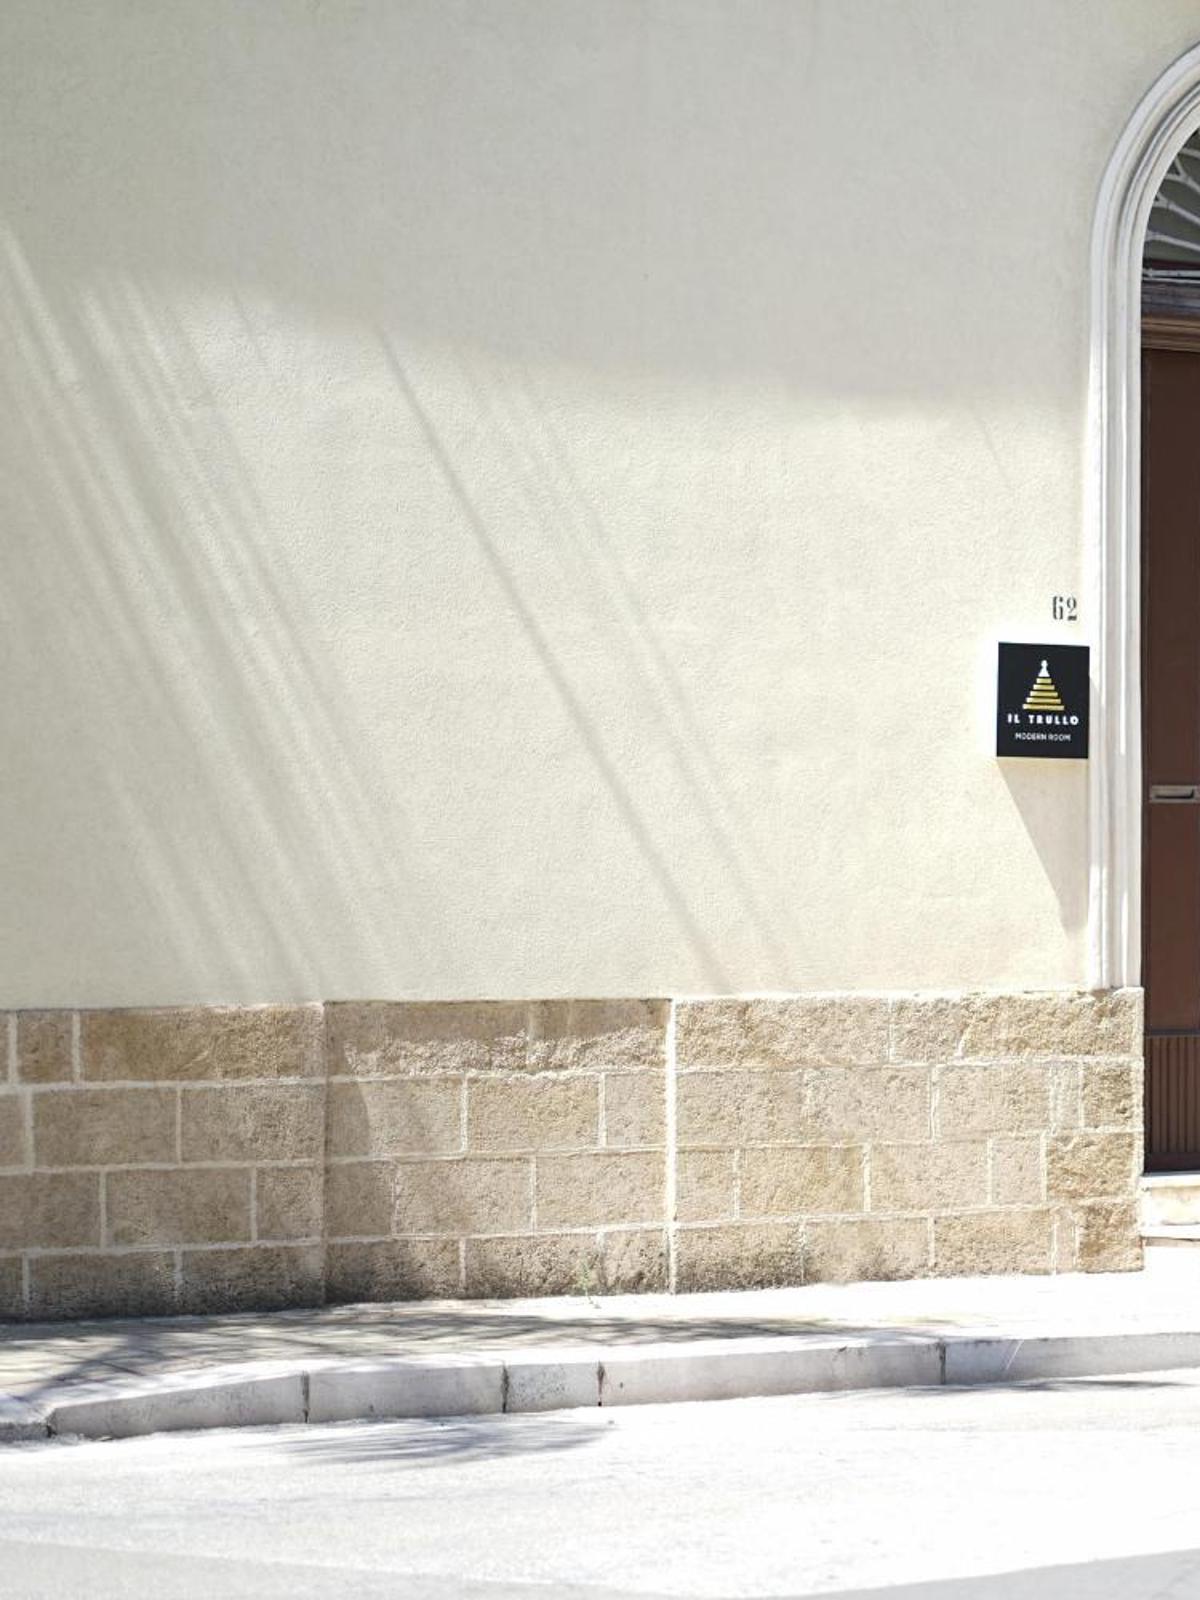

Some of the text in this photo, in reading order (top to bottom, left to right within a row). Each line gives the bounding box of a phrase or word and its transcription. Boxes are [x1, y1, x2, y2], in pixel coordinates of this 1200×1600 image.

[1052, 595, 1078, 621] 62
[1007, 713, 1079, 726] IL TRULLO
[1015, 732, 1072, 742] MODERN ROOM
